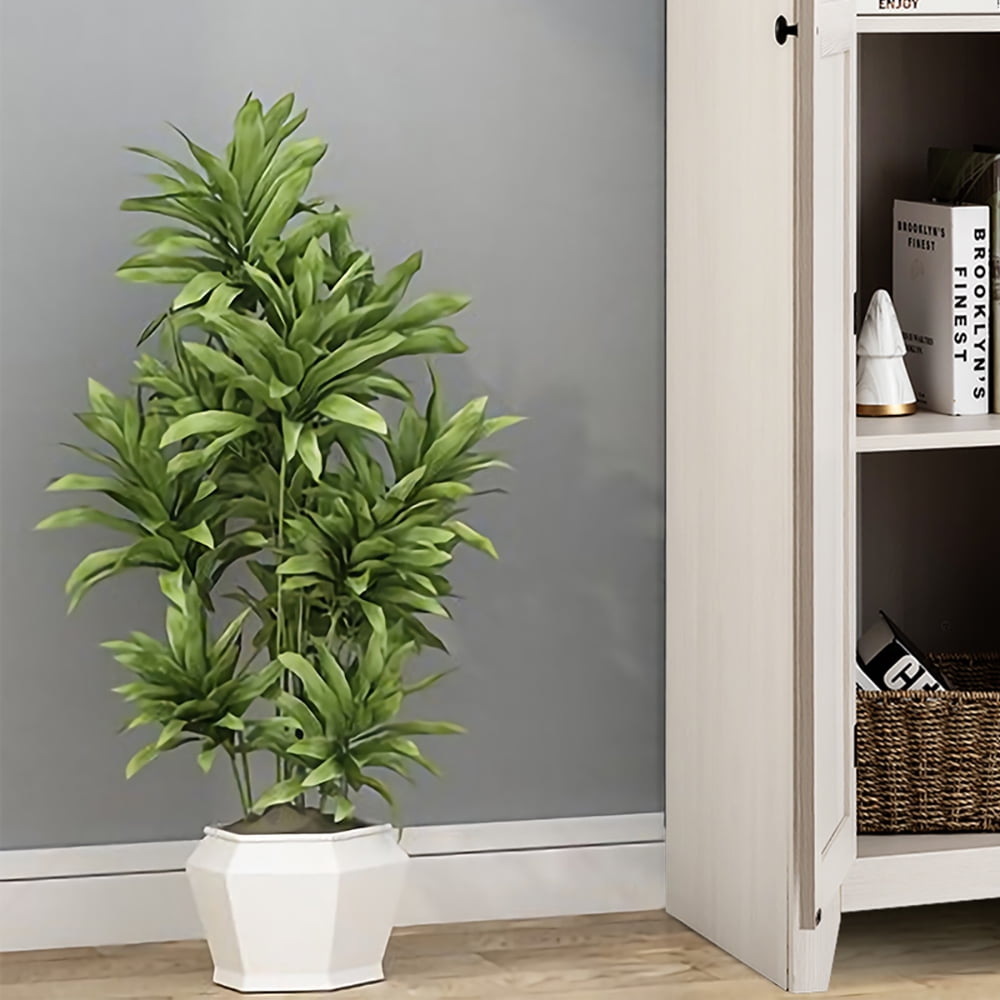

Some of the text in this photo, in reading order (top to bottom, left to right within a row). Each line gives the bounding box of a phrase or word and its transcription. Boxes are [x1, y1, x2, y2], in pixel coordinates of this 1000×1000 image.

[897, 221, 945, 238] BROOKLYN'S
[908, 237, 935, 251] FINEST
[954, 267, 967, 362] FINEST
[973, 228, 986, 399] BROOKLYN'S
